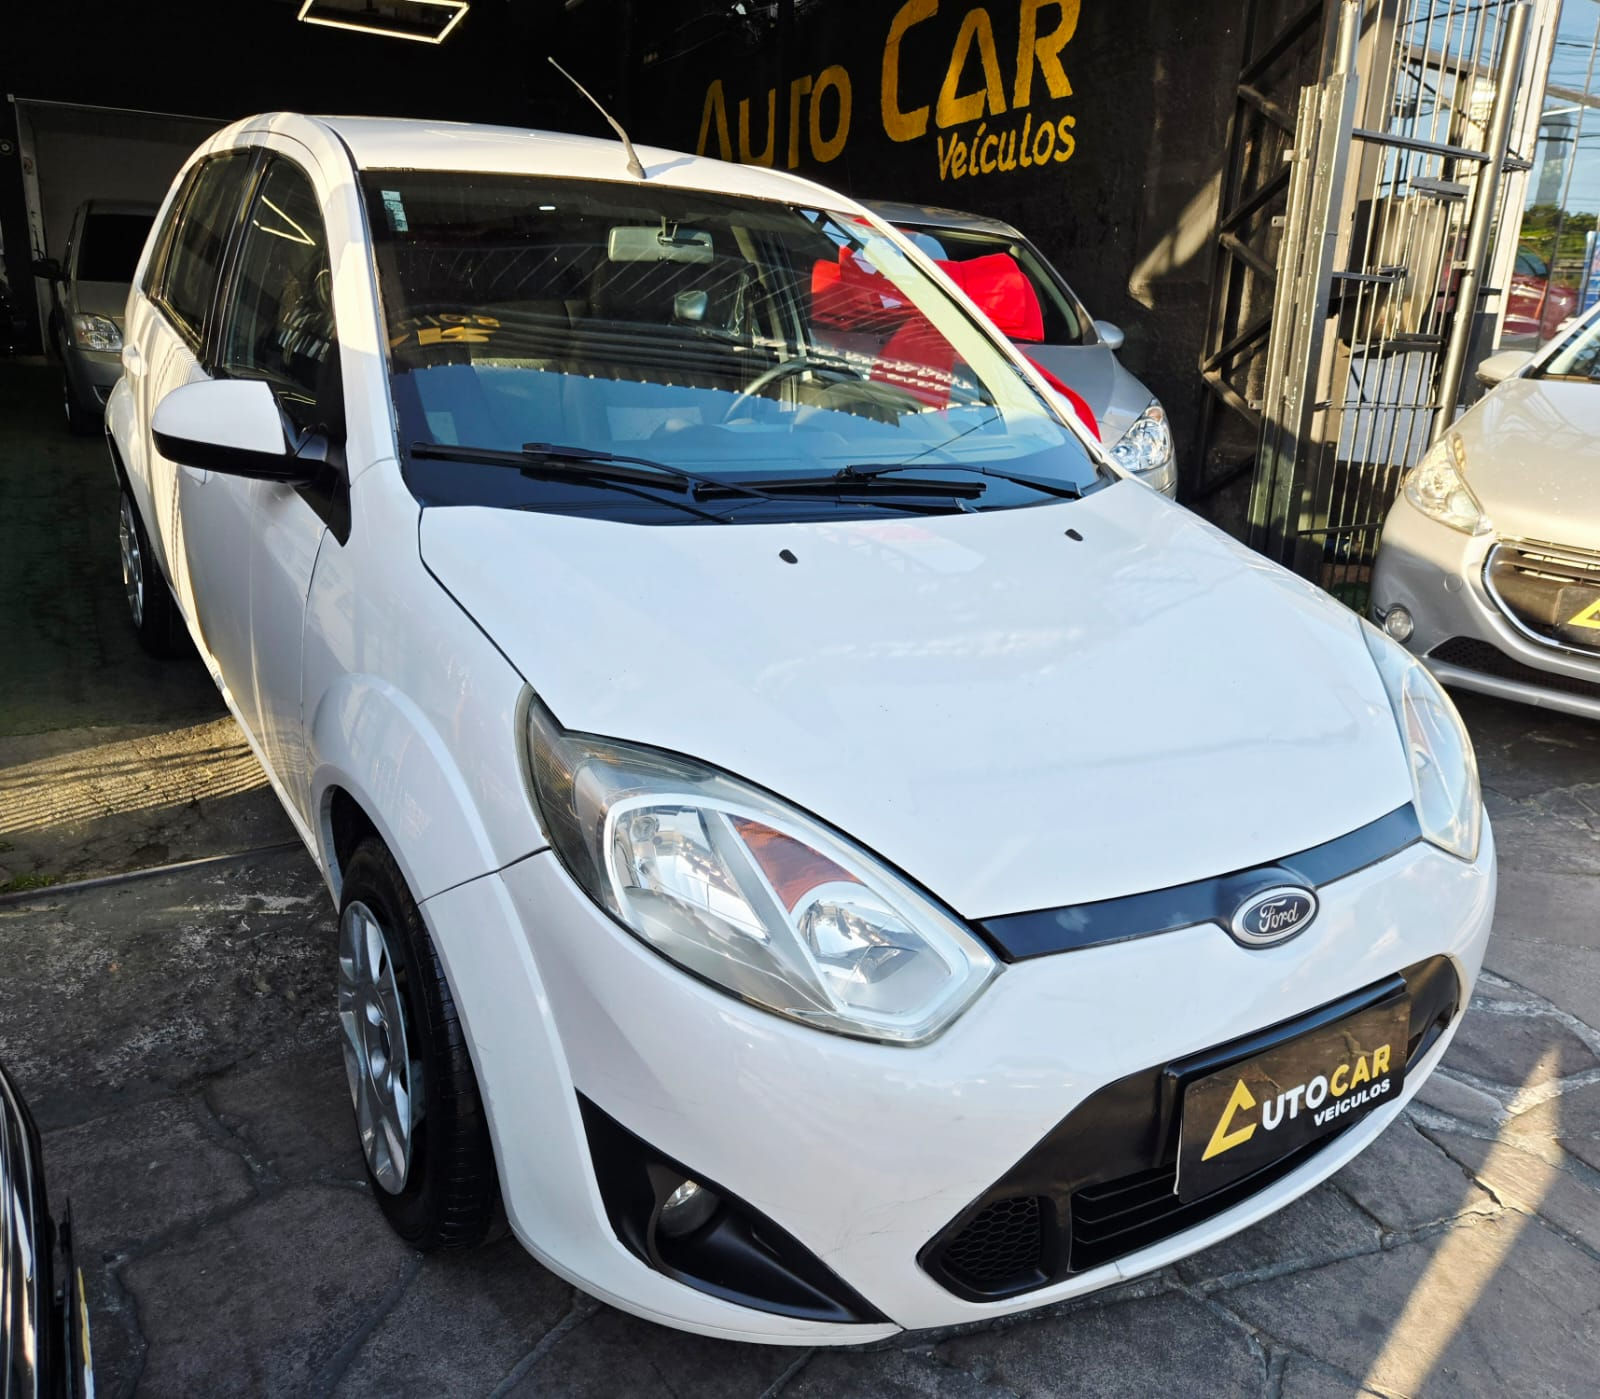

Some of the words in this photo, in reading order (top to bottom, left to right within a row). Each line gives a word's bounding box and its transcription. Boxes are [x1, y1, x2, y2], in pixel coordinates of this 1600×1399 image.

[881, 0, 1081, 142] CAR
[937, 113, 1077, 181] Veículos
[1259, 899, 1299, 932] Ford
[1314, 1078, 1391, 1127] VEÍCULOS
